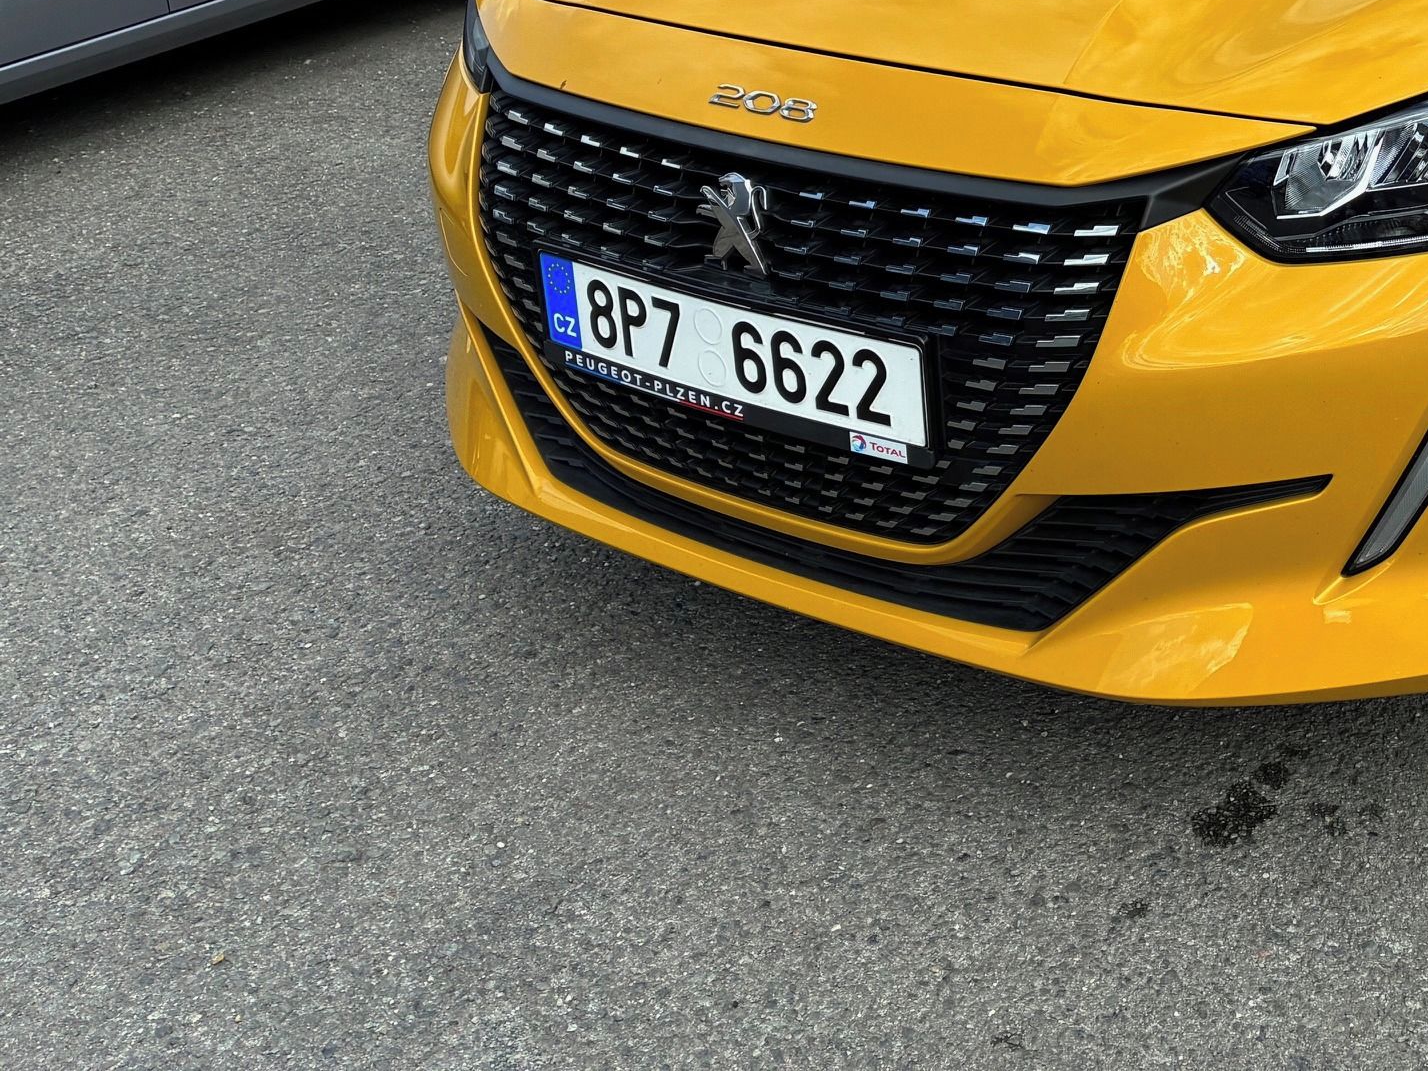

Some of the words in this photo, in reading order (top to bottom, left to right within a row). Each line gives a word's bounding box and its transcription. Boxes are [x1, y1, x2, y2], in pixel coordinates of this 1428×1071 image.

[708, 83, 818, 123] 208
[553, 313, 578, 338] CZ
[586, 279, 680, 369] 8P7
[731, 320, 892, 427] 6622
[565, 350, 744, 417] PEUGEOT-PLZEN.CZ
[869, 441, 906, 458] TOTAL
